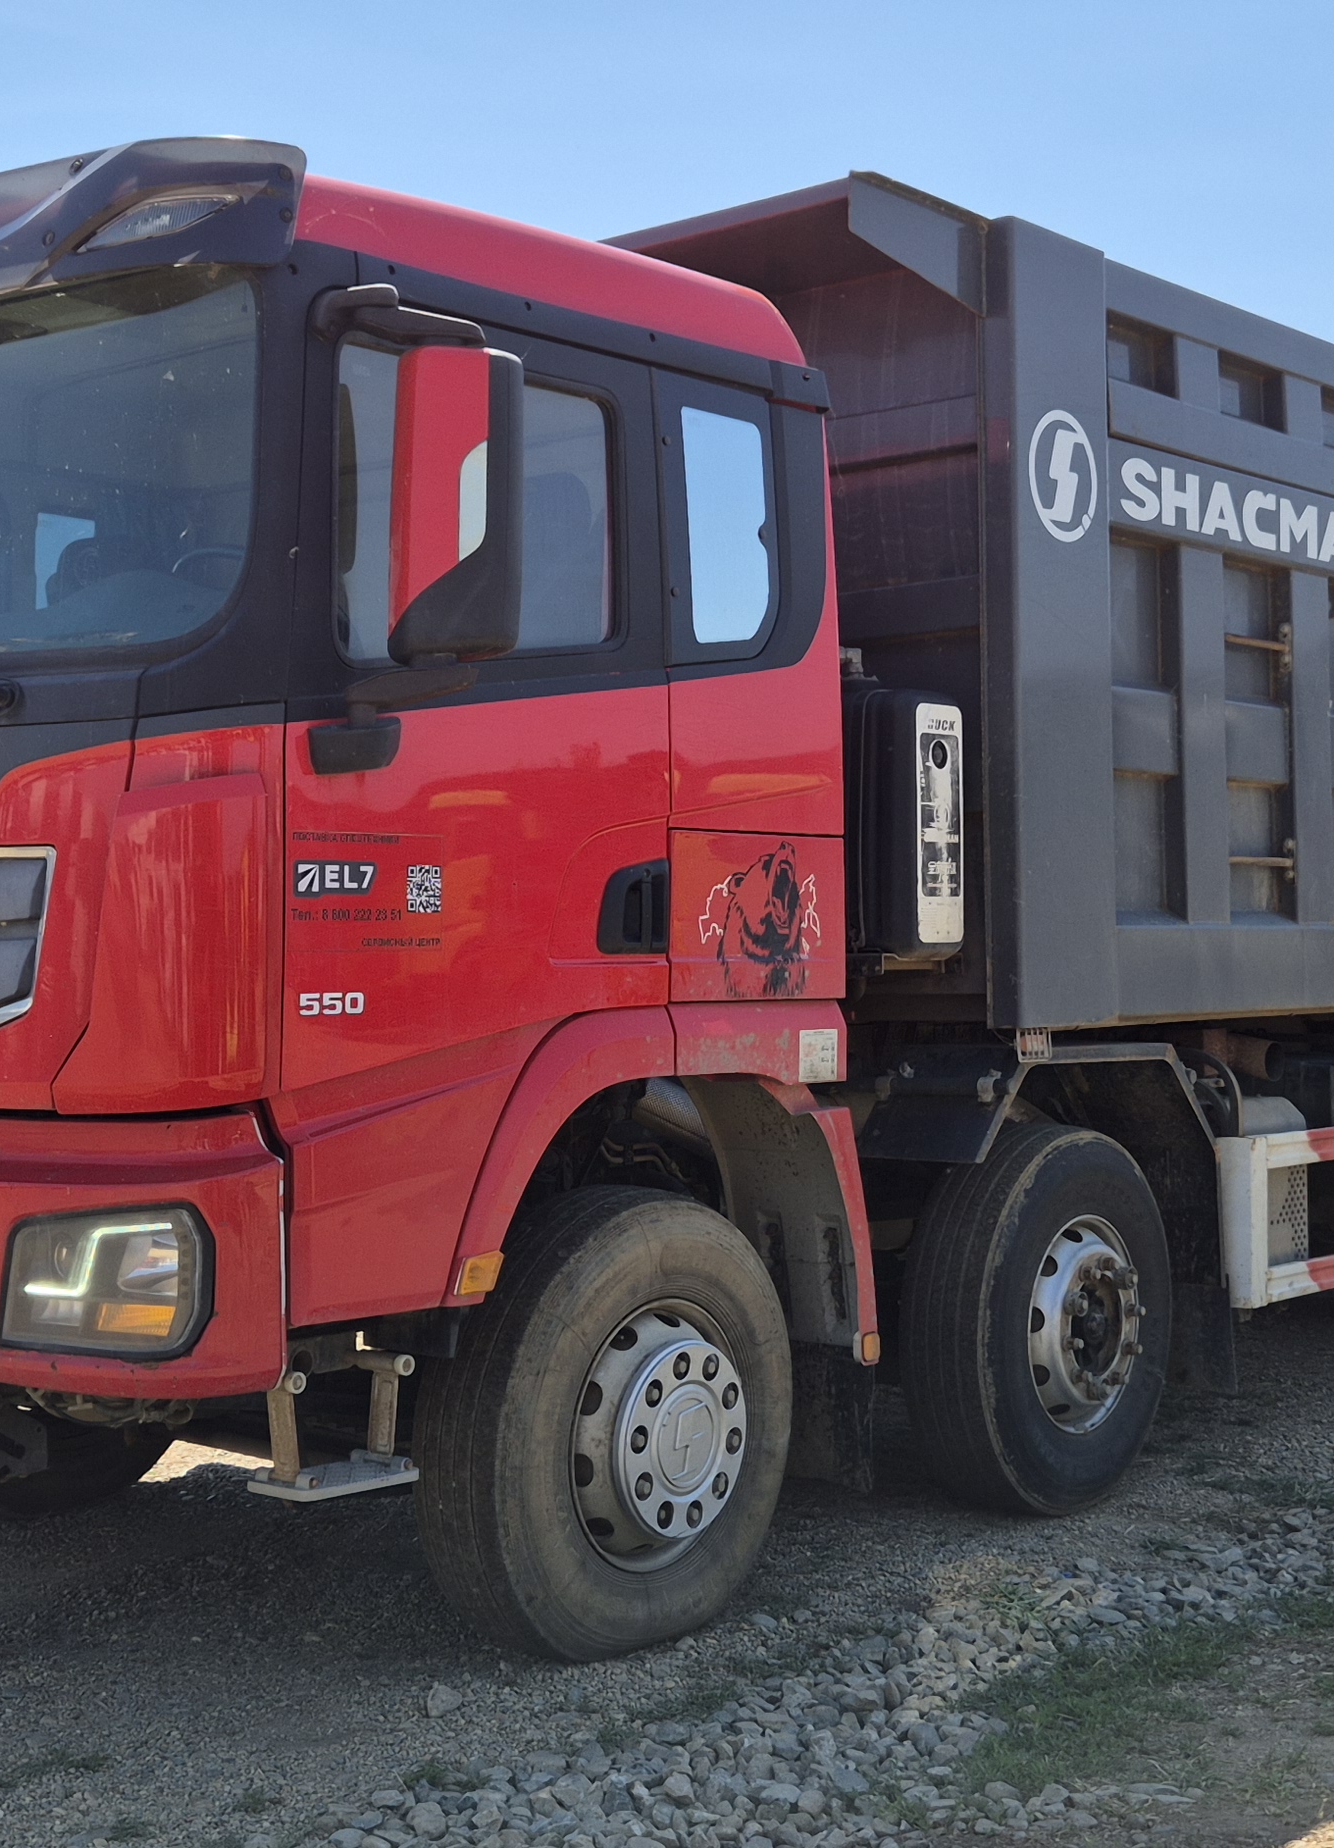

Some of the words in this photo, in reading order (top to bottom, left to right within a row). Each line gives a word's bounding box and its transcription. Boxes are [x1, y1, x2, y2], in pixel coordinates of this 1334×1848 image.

[324, 864, 375, 890] EL7
[291, 908, 319, 922] Тел.:
[322, 908, 329, 921] 8
[353, 908, 372, 921] 222
[390, 908, 402, 921] 51
[361, 937, 413, 948] СЕРВИСНЫЙ
[415, 937, 441, 948] ЦЕНТР
[299, 991, 365, 1016] 550
